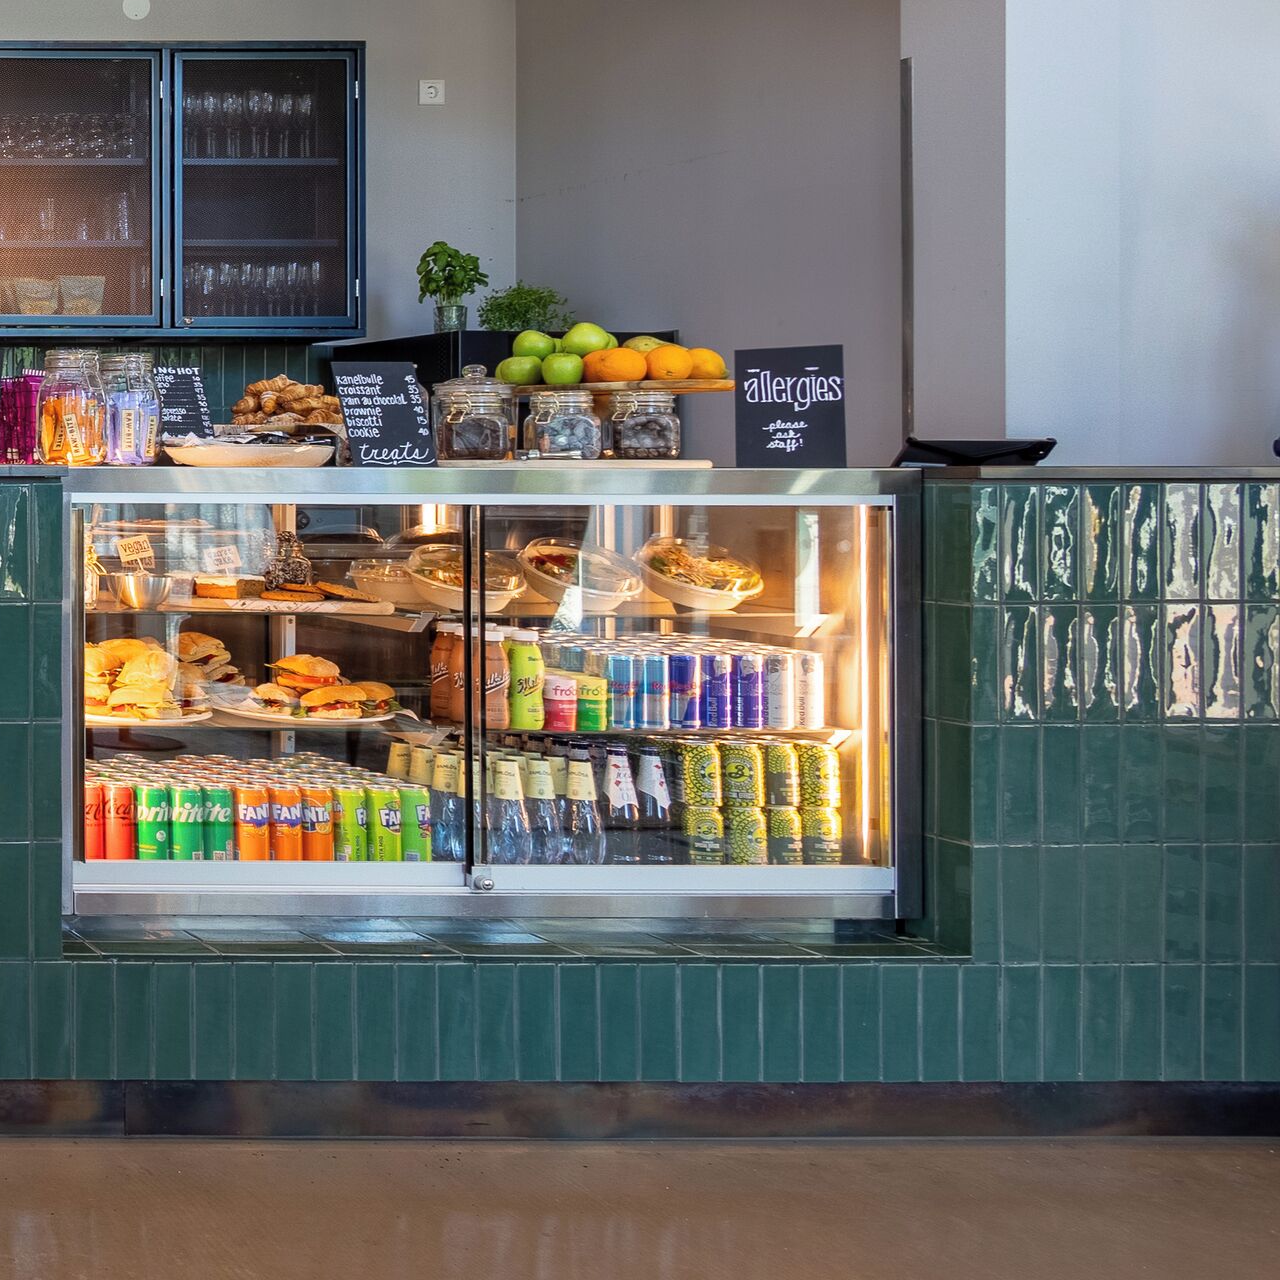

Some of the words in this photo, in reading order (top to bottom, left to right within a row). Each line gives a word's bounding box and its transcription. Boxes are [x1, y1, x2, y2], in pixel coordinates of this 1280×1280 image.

[176, 367, 201, 375] HOT
[154, 374, 175, 383] offee
[338, 384, 382, 395] croissant
[407, 384, 419, 394] 35
[743, 370, 842, 412] allergies
[362, 396, 372, 405] au
[373, 393, 408, 405] chocolat
[410, 394, 422, 404] 35
[344, 405, 383, 416] brownie
[413, 406, 424, 414] 40
[346, 416, 383, 427] biscotti
[416, 416, 428, 425] 15
[762, 419, 808, 432] please
[348, 427, 381, 438] cookie
[418, 428, 430, 436] 40
[771, 430, 801, 439] ask
[358, 441, 430, 460] treats
[766, 438, 804, 453] staff!
[120, 539, 150, 556] vegan
[203, 801, 231, 822] ite
[303, 805, 330, 822] NTA
